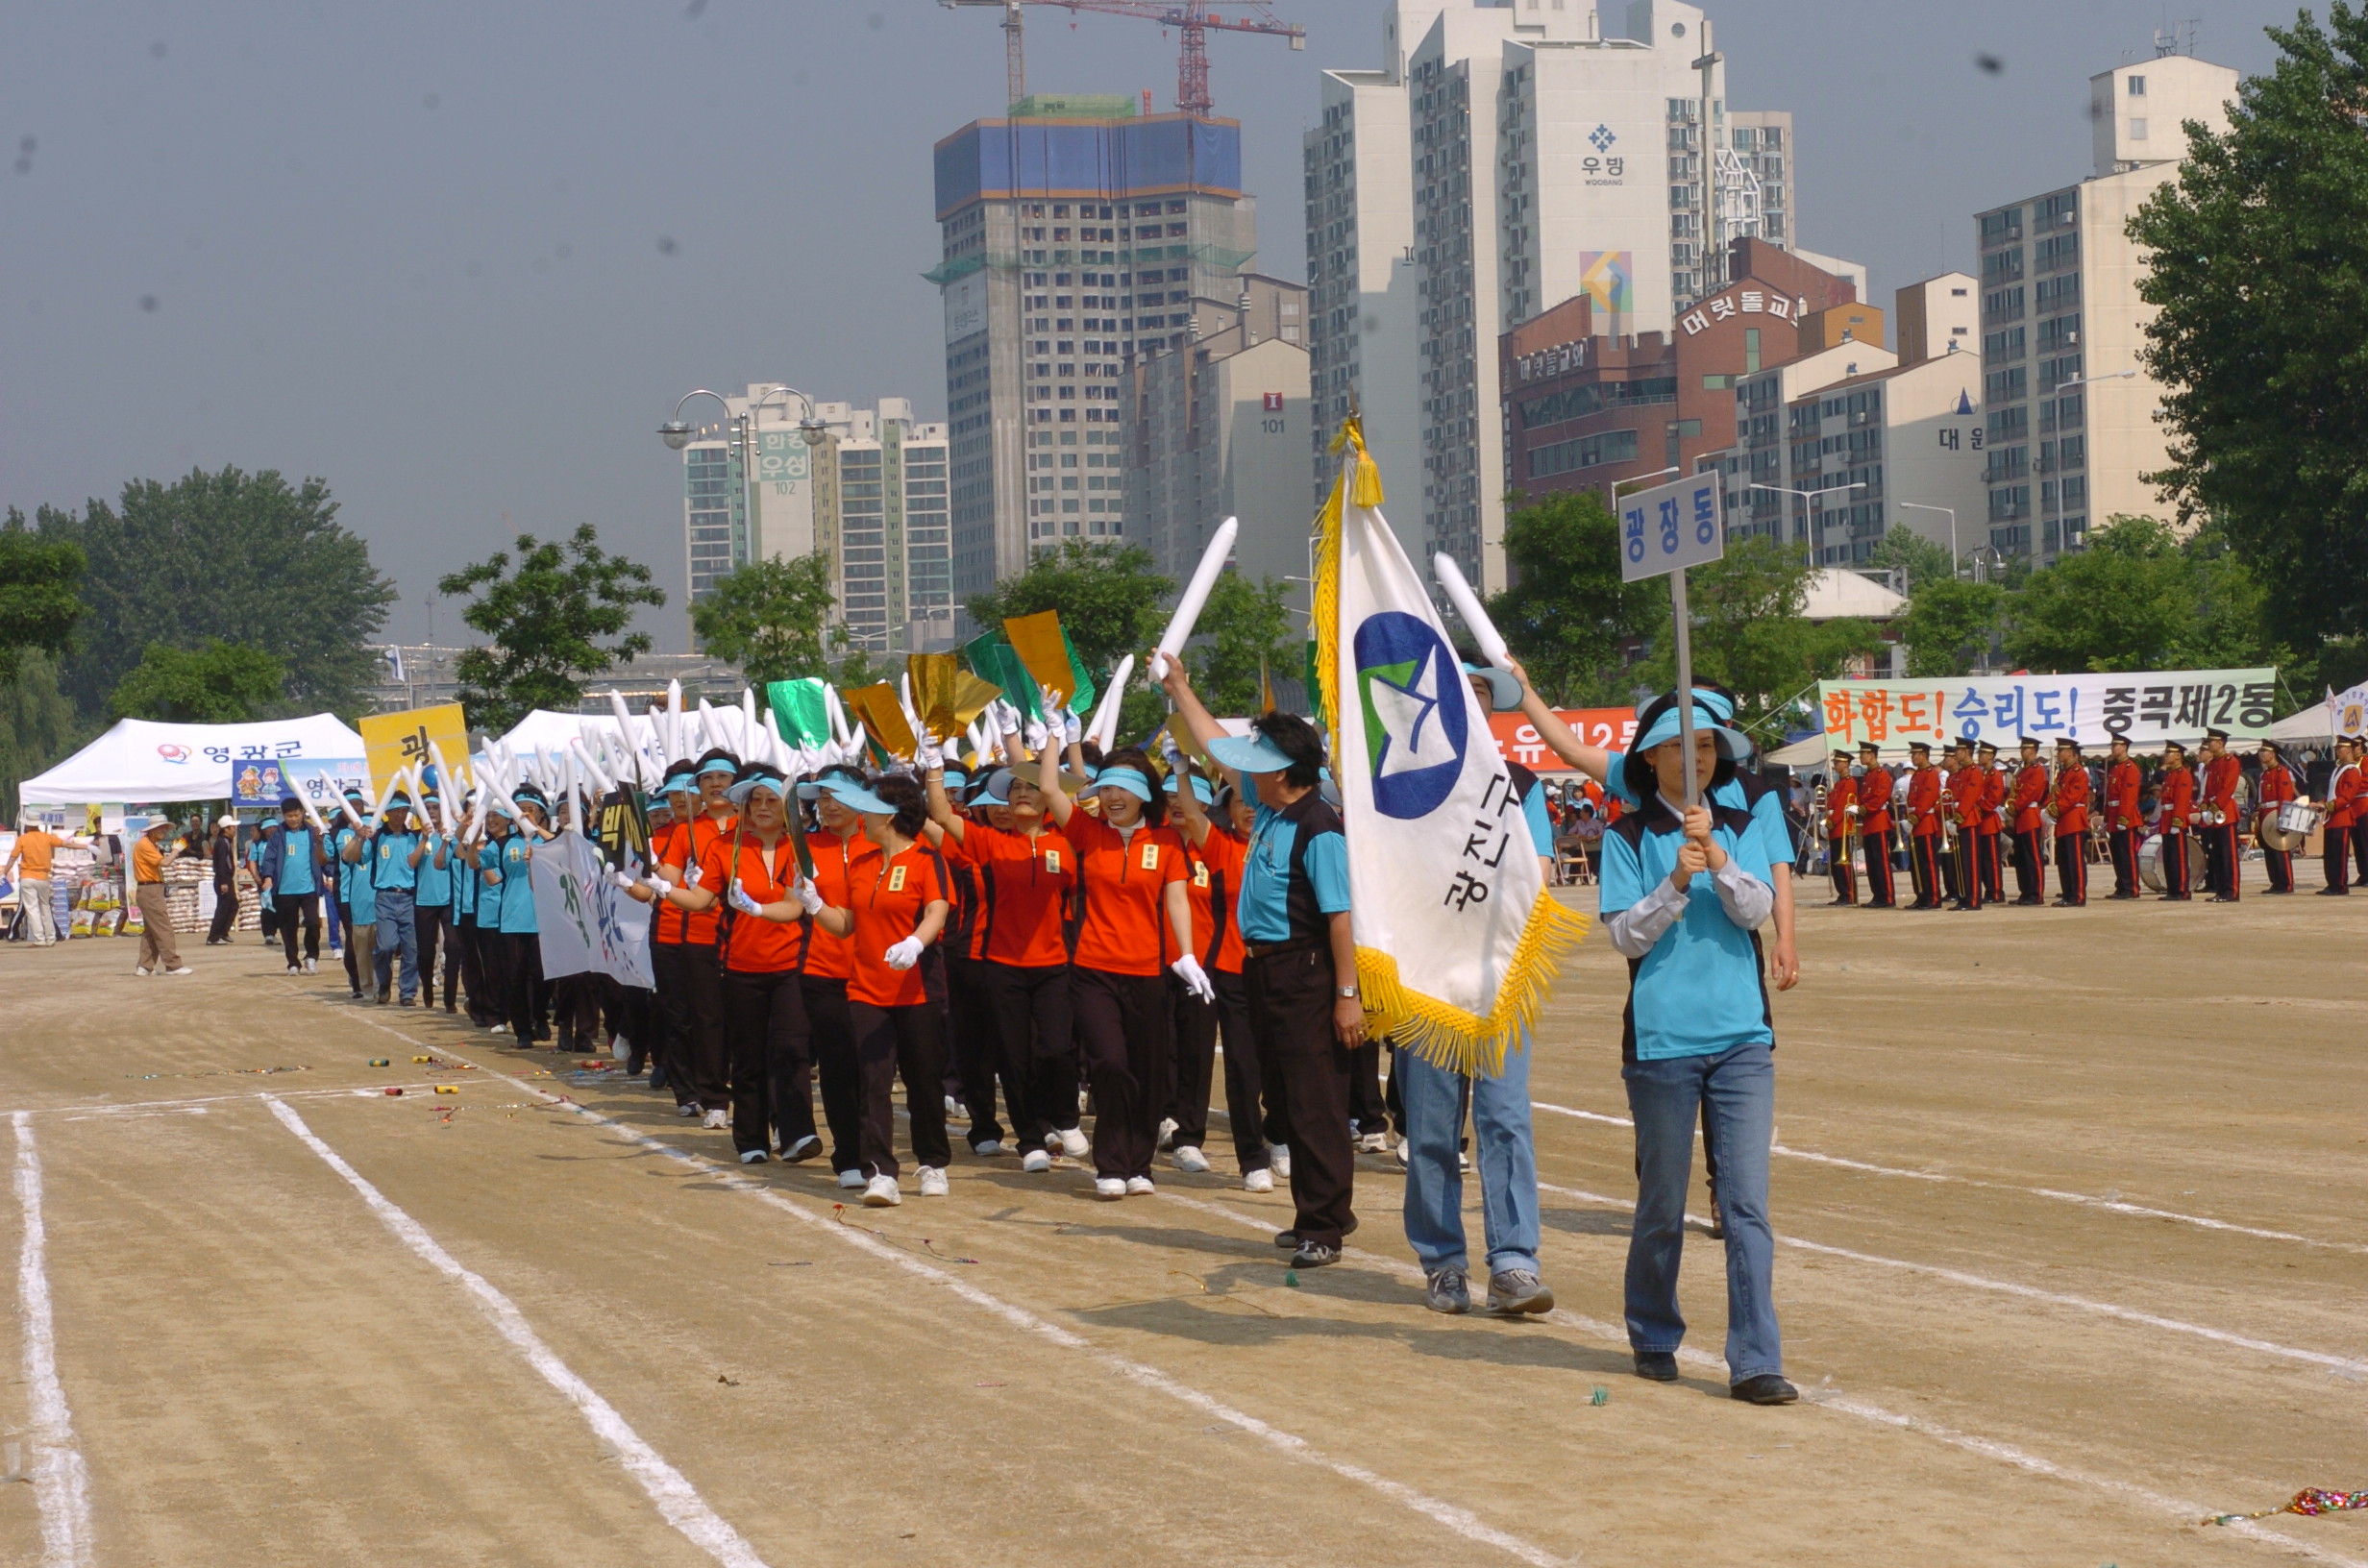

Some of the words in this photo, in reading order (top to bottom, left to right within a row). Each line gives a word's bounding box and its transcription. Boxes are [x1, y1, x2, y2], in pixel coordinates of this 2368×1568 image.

[1582, 157, 1624, 177] 우방
[1261, 419, 1286, 434] 101
[761, 455, 806, 478] 우성
[775, 481, 797, 496] 102
[1626, 487, 1714, 563] 광장동
[1823, 689, 1945, 745] 화합도!
[1953, 685, 2078, 742] 승리도!
[2103, 682, 2276, 734] 중곡제2동
[204, 741, 303, 764] 영광군
[402, 725, 431, 766] 광
[1443, 773, 1520, 912] 광진구
